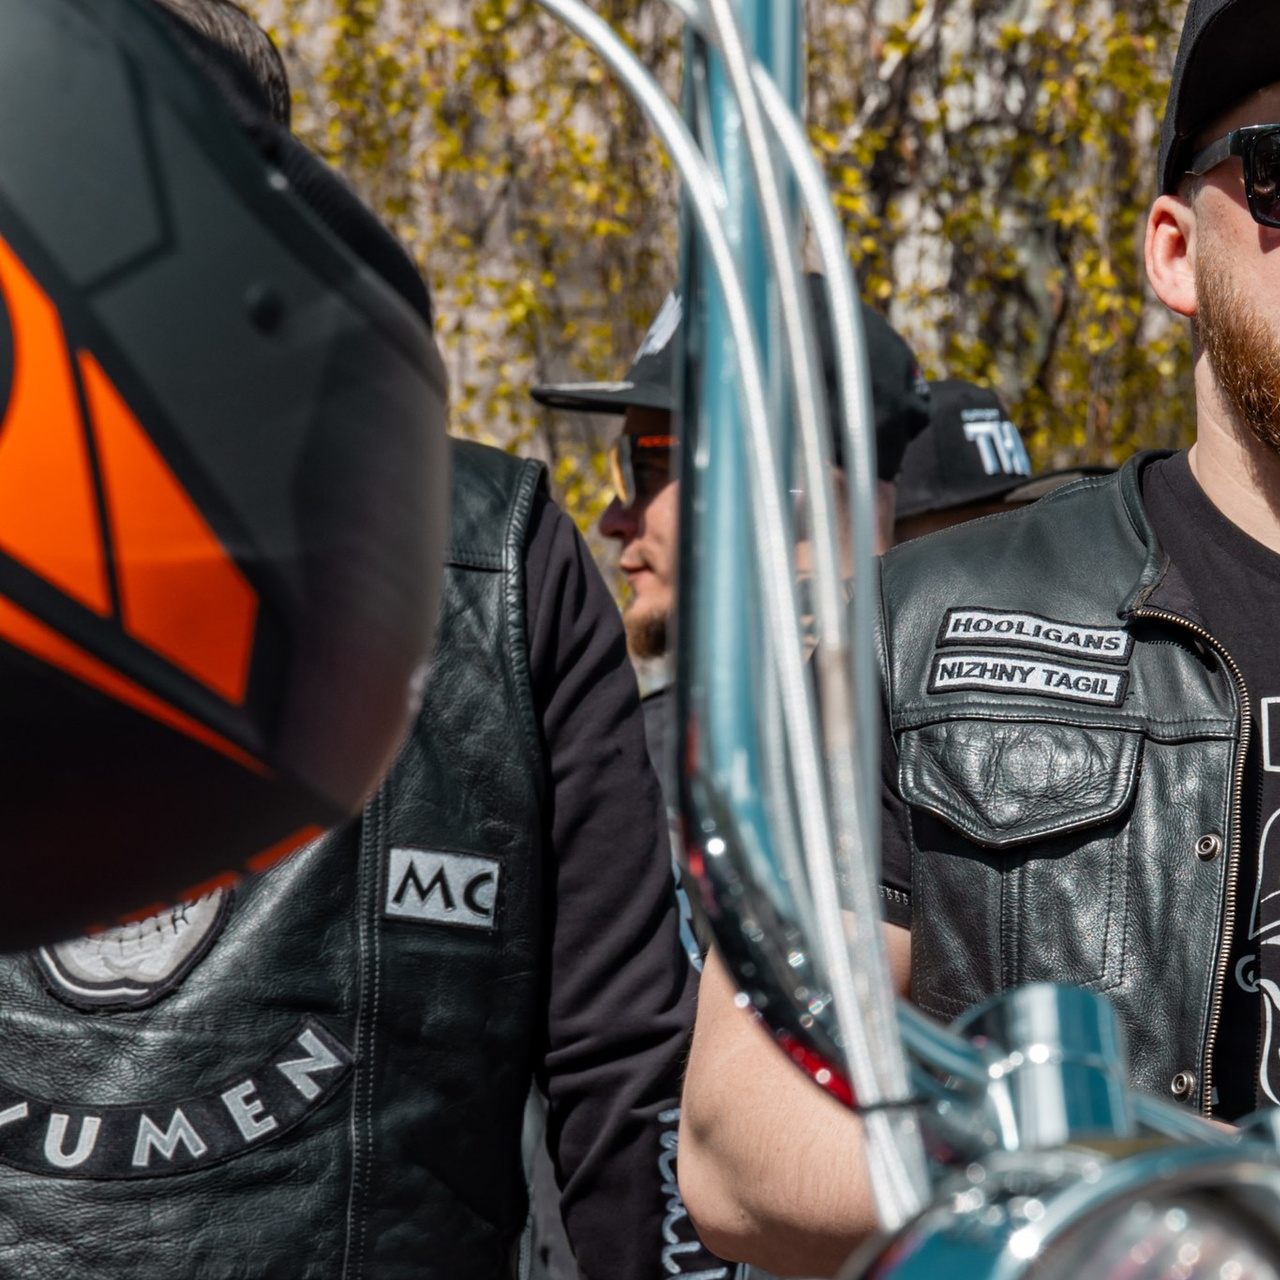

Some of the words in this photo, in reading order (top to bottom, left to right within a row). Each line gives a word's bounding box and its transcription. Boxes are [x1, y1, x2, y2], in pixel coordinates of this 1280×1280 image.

[951, 617, 1122, 652] HOOLIGANS
[938, 661, 1036, 684] NIZHNY
[1041, 668, 1115, 697] TAGIL
[391, 858, 494, 918] MC
[0, 1027, 345, 1169] UMEN
